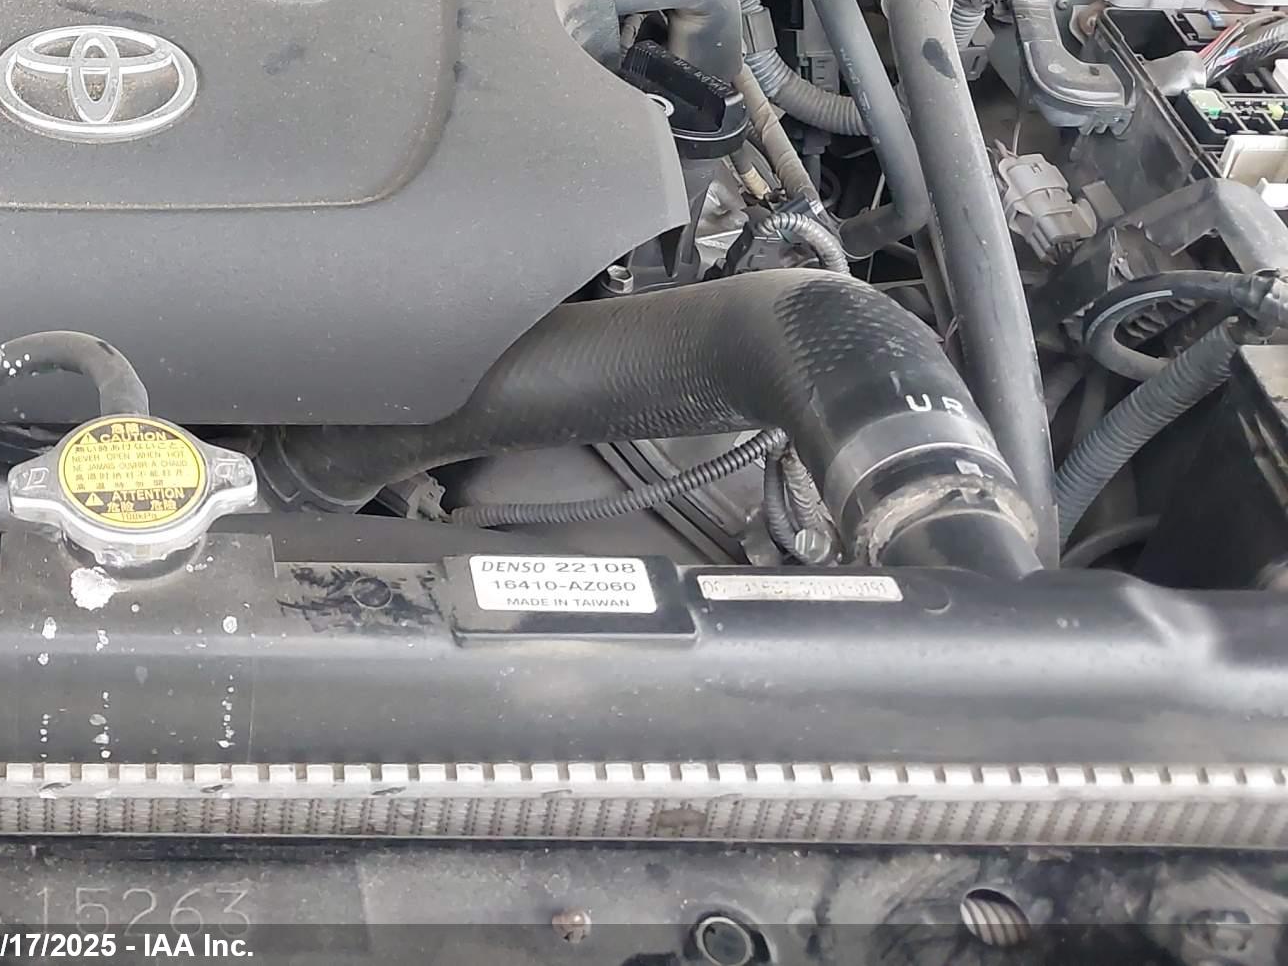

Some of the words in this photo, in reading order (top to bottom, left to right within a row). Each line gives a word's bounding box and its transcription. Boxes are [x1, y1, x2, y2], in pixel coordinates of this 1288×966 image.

[100, 431, 168, 442] CAUTION
[72, 453, 100, 463] NEVER
[106, 452, 130, 461] OPEN
[136, 451, 161, 460] WHEN
[167, 450, 184, 459] HOT
[112, 487, 186, 502] ATTENTION
[481, 560, 546, 574] DENSO
[555, 561, 637, 575] 22108
[493, 579, 637, 592] 16410-AZ060
[506, 597, 551, 607] MADE
[554, 598, 569, 608] IN
[573, 598, 631, 609] TAIWAN
[36, 886, 252, 937] 15263
